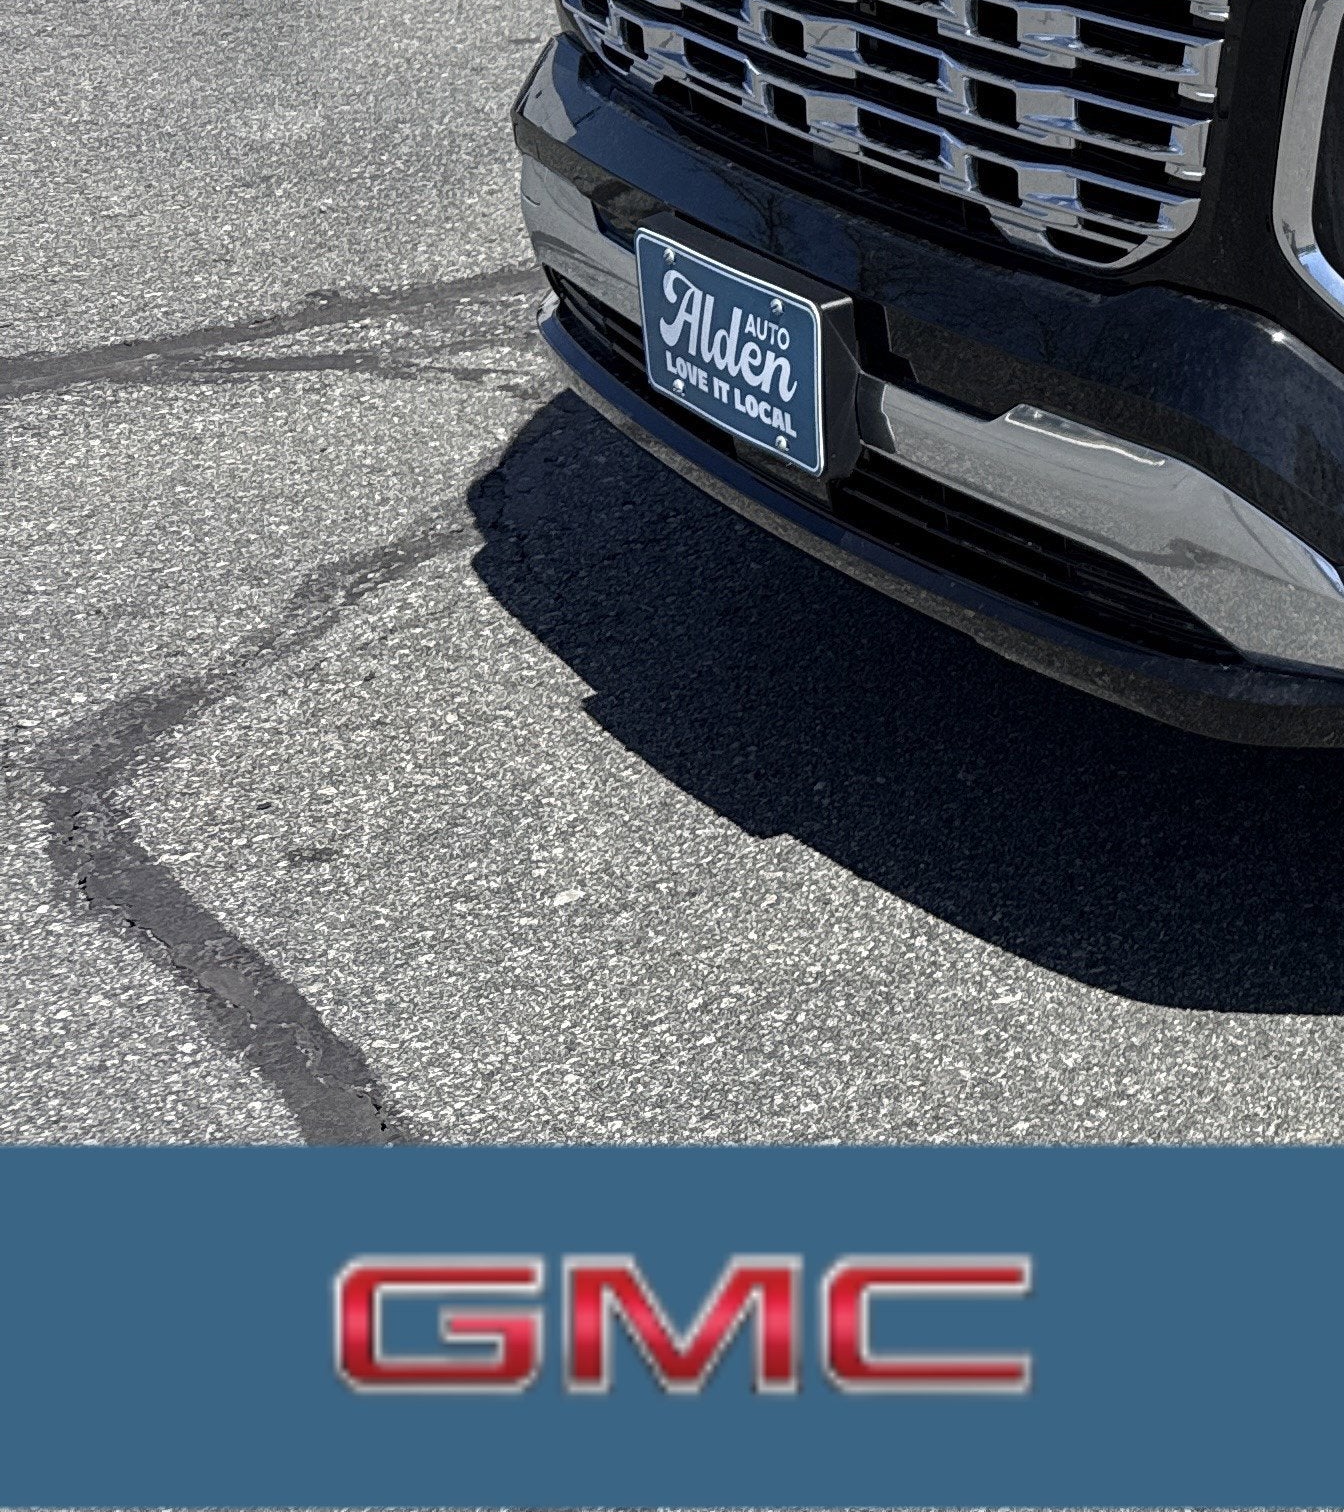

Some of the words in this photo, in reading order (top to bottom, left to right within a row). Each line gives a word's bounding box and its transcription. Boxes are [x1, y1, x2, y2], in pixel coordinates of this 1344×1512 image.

[659, 269, 798, 403] Alden
[745, 313, 791, 350] AUTO
[665, 350, 709, 393] LOVE
[712, 376, 731, 405] IT
[733, 388, 797, 439] LOCAL
